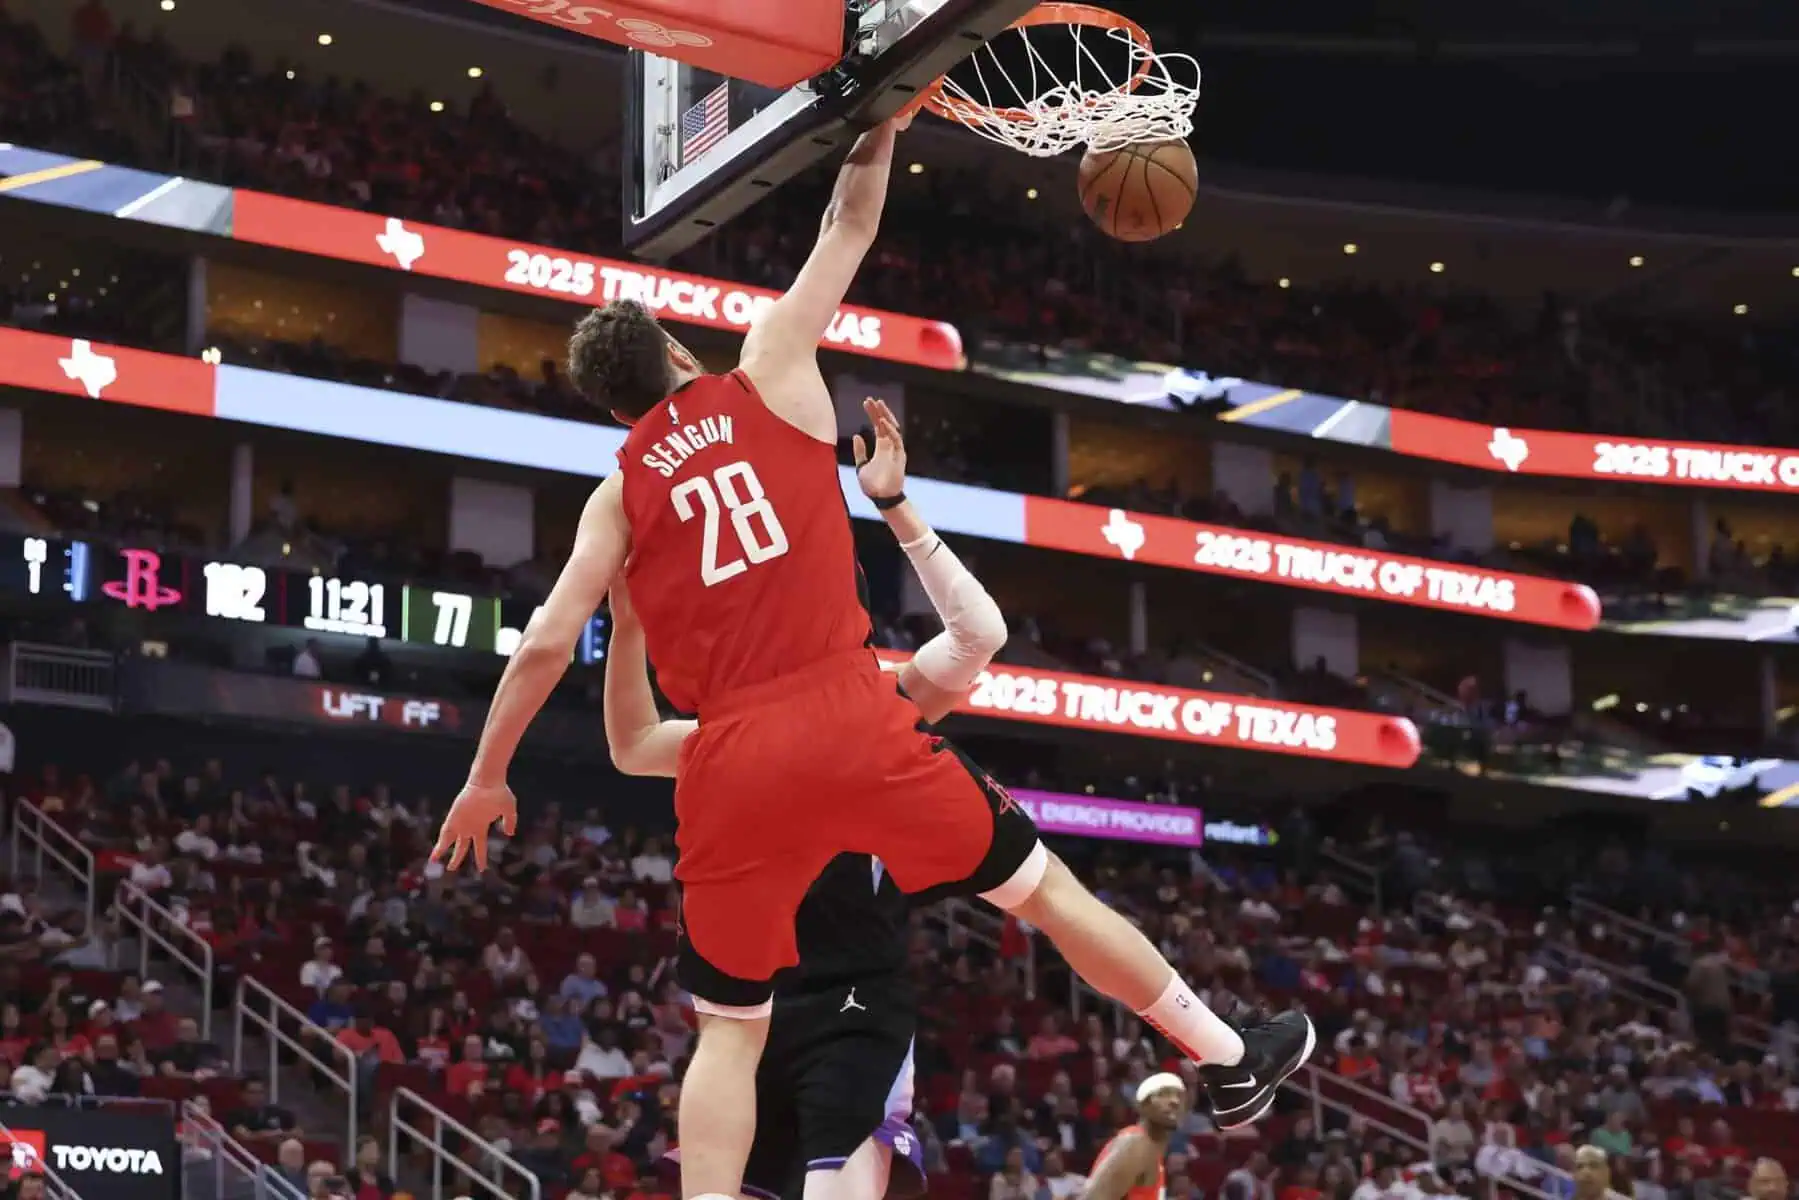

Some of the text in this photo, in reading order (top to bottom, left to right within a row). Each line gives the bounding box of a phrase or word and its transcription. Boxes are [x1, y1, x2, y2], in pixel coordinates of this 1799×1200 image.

[505, 250, 595, 296] 2025
[600, 266, 720, 321] TRUCK
[642, 414, 734, 478] SENGUN
[1593, 442, 1669, 477] 2025
[1672, 448, 1777, 484] TRUCK
[670, 461, 789, 587] 28
[1195, 531, 1516, 612] 2025 TRUCK OF TEXAS
[432, 592, 473, 648] 77
[969, 671, 1337, 750] 2025 TRUCK OF TEXAS
[52, 1145, 163, 1174] TOYOTA
